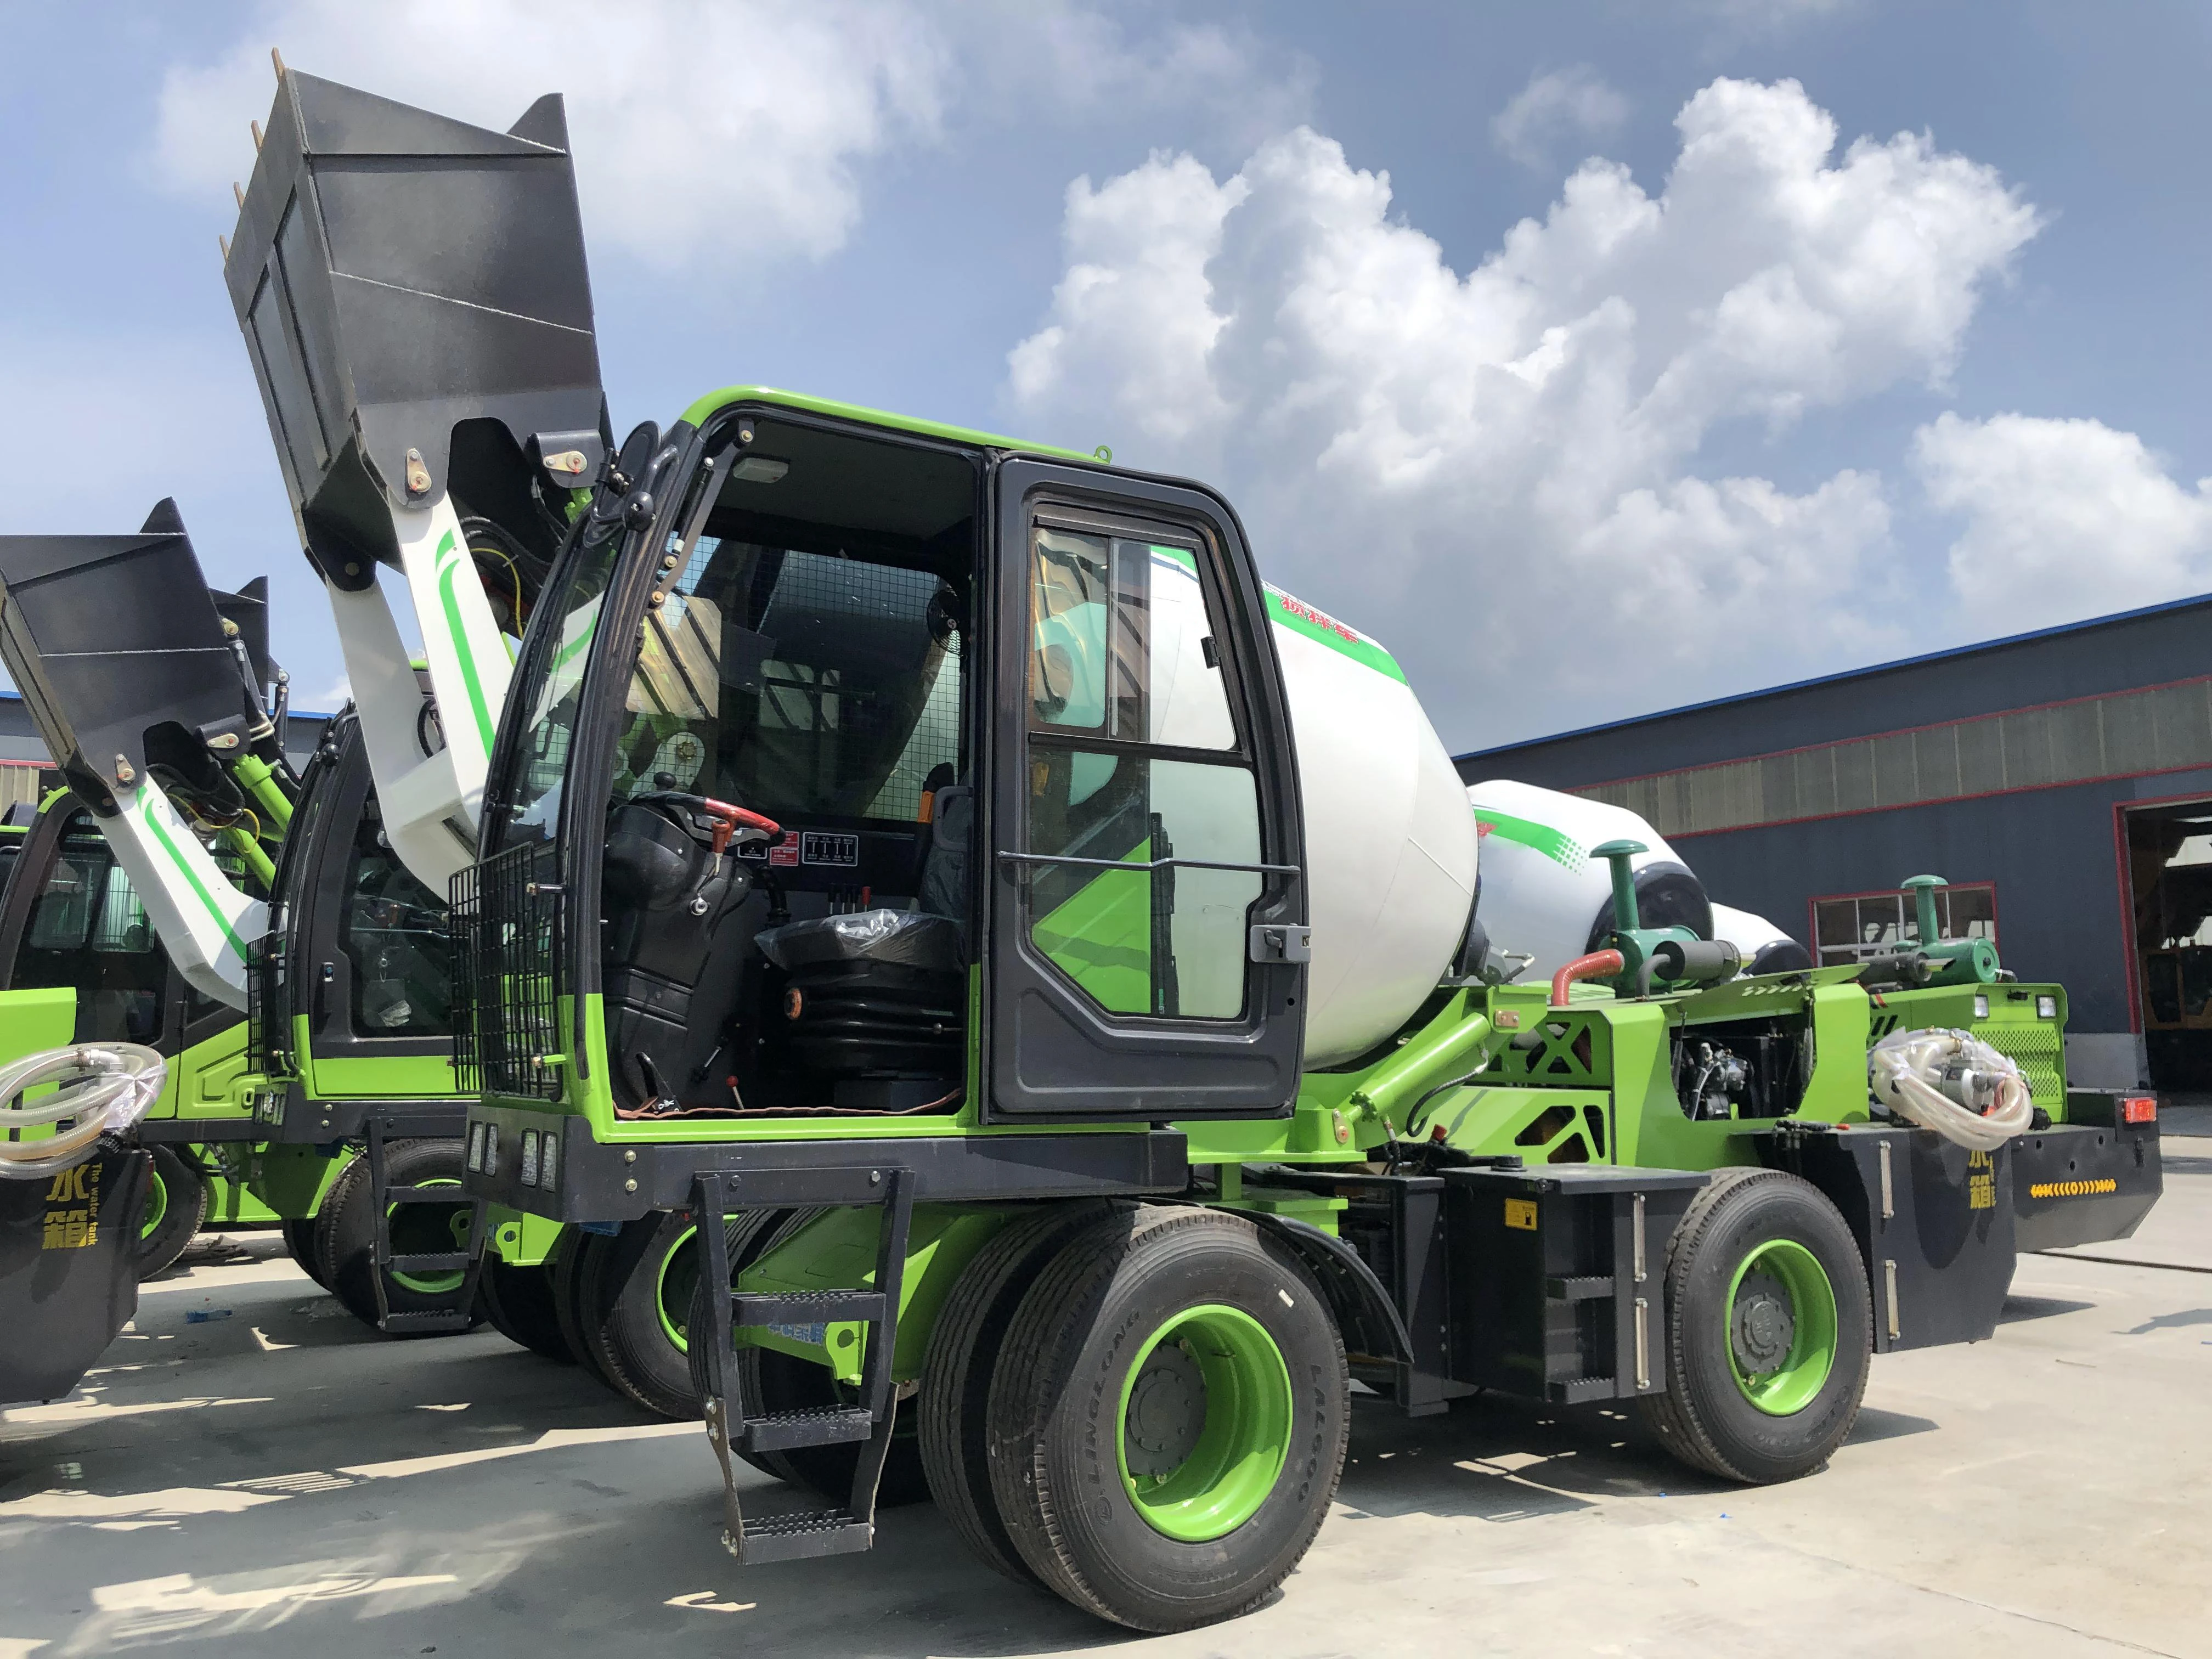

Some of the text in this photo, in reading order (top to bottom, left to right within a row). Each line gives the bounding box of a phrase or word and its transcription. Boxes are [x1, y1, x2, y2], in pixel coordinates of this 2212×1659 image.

[42, 1164, 89, 1249] 水箱
[88, 1163, 103, 1246] The water tank
[1084, 1311, 1140, 1484] LINGLONG
